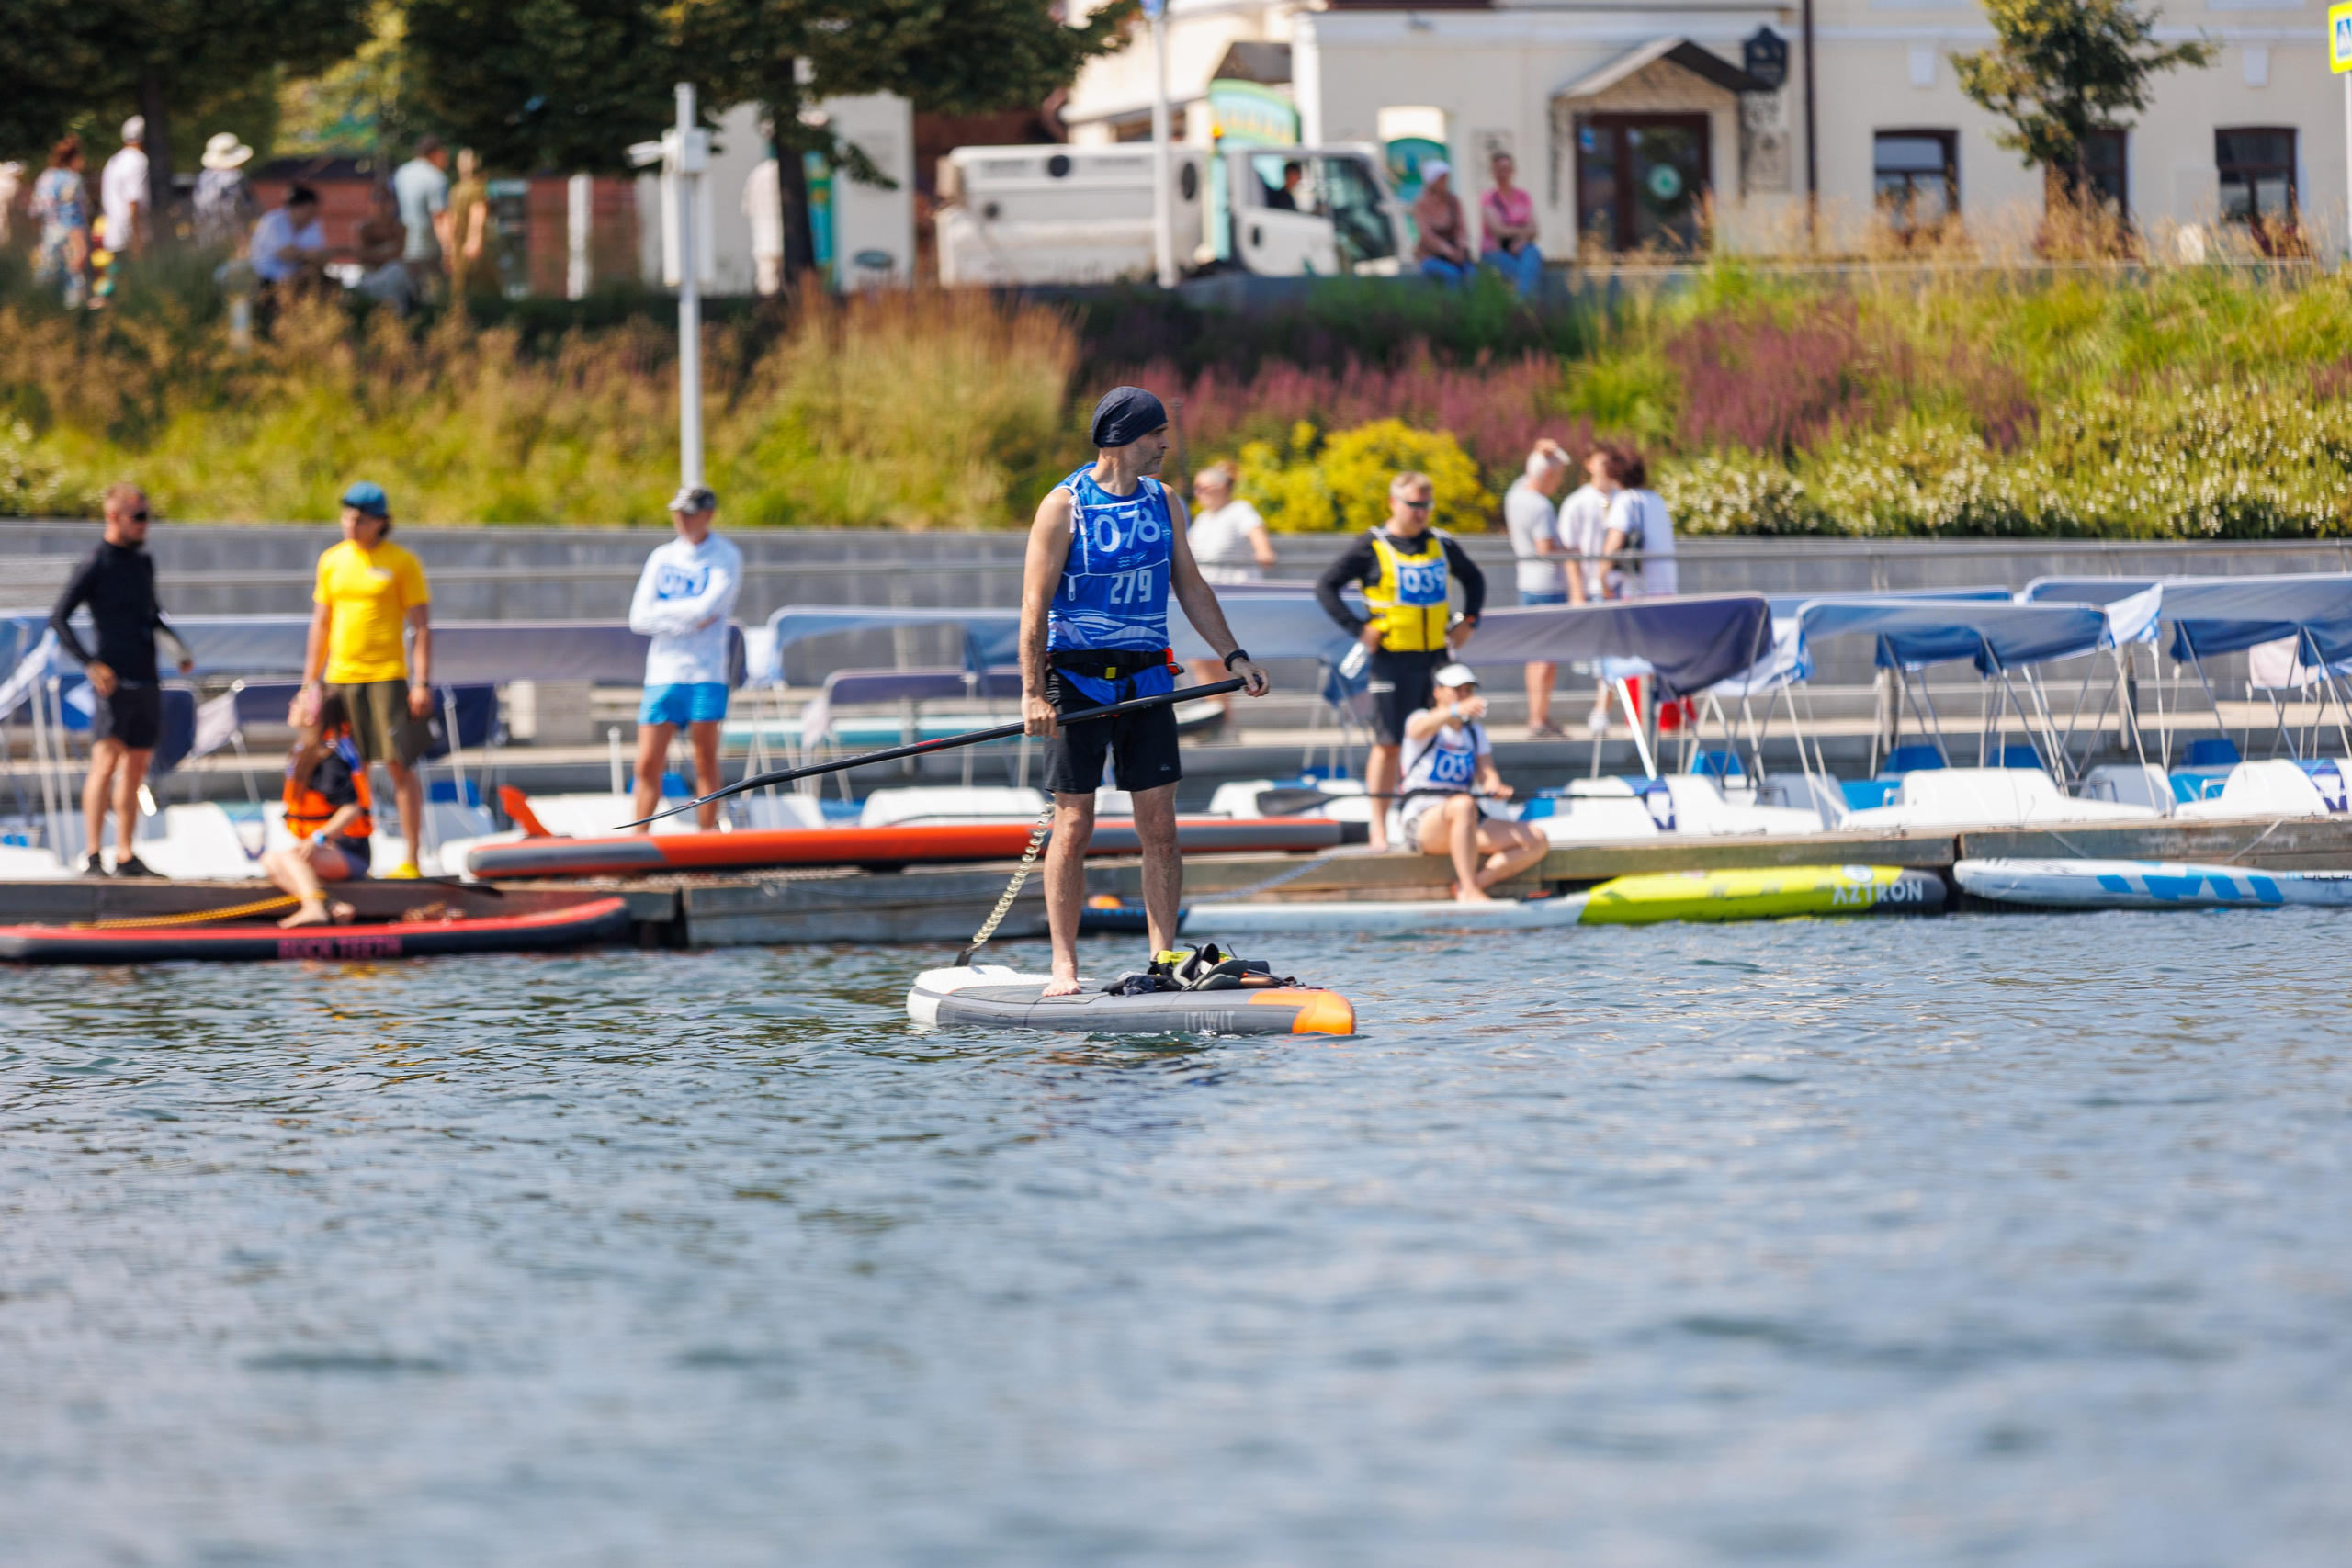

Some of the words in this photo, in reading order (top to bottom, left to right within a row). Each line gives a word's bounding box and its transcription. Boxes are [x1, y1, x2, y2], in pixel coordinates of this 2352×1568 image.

[1093, 507, 1160, 553] 078
[1109, 569, 1153, 604] 279
[1832, 879, 1924, 906] AZTRON
